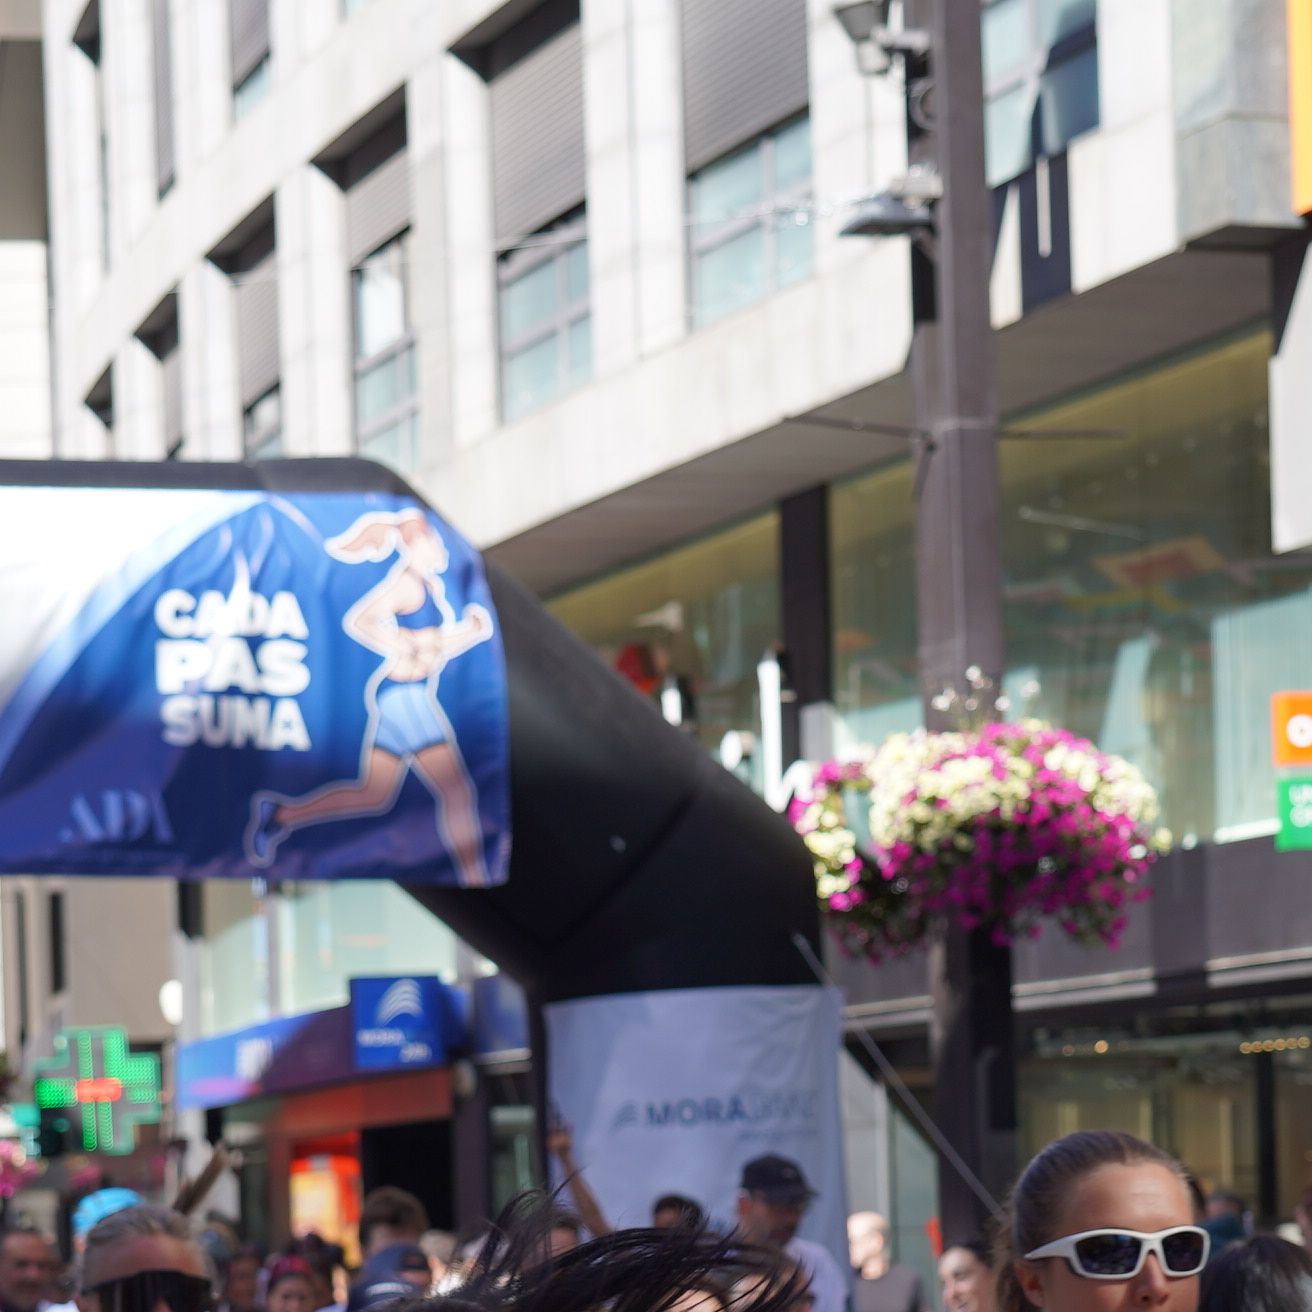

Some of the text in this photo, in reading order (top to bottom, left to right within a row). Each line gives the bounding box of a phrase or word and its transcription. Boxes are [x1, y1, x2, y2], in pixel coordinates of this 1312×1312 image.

[153, 588, 310, 642] CADA
[155, 637, 312, 695] PAS
[158, 697, 313, 751] SUMA
